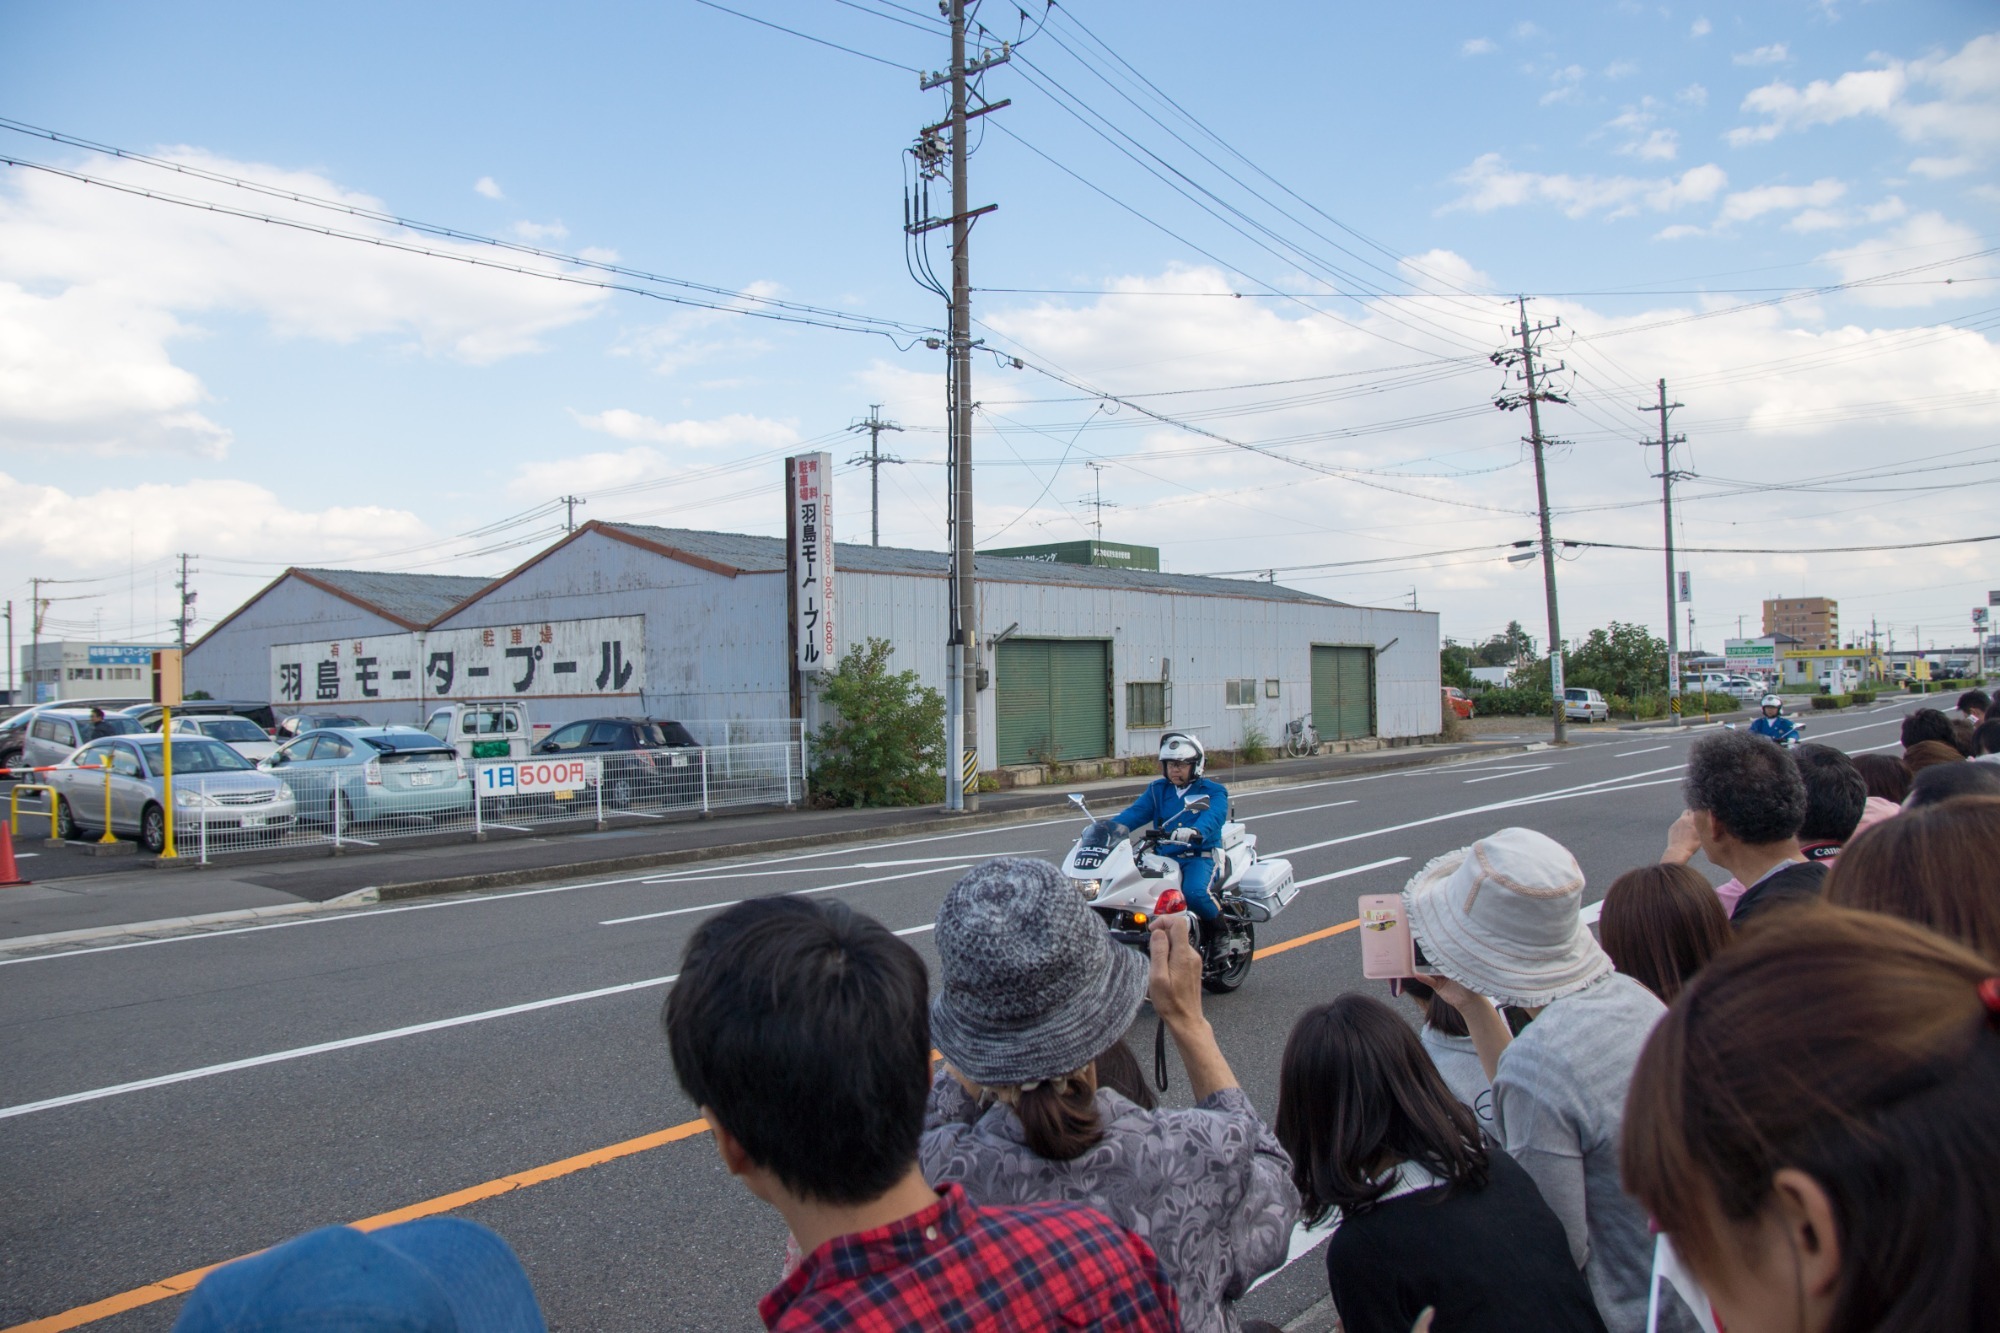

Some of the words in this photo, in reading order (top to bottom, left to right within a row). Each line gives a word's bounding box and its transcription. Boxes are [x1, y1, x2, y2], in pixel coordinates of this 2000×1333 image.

[799, 461, 809, 501] 駐車場
[808, 461, 818, 499] 有料
[331, 641, 363, 658] 有料
[483, 625, 553, 647] 駐車場
[281, 641, 633, 701] 羽島モータープール
[483, 767, 515, 789] 1日
[520, 763, 584, 786] 500円
[1074, 857, 1102, 868] GIFU
[1079, 846, 1110, 855] POLICE
